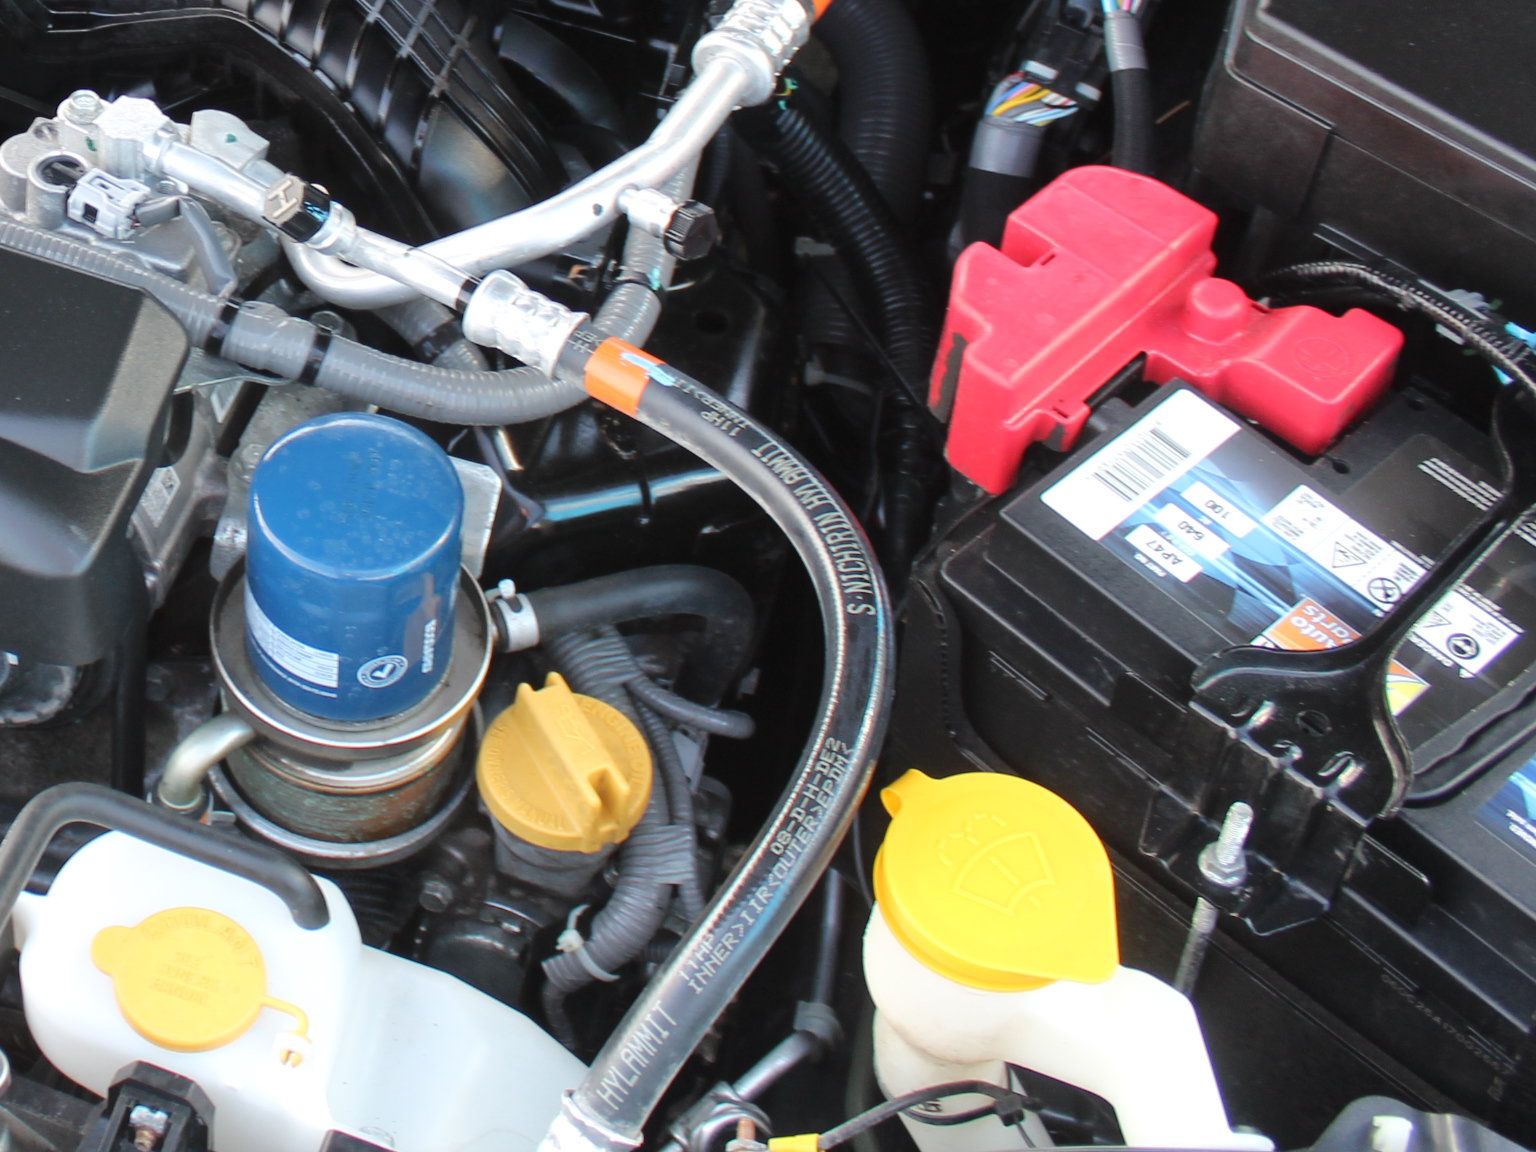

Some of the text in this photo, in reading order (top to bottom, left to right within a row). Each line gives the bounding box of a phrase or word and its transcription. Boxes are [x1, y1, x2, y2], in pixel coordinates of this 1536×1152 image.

[1176, 519, 1205, 542] 640
[1144, 539, 1183, 566] AP47
[595, 998, 678, 1112] HYLAMMIT
